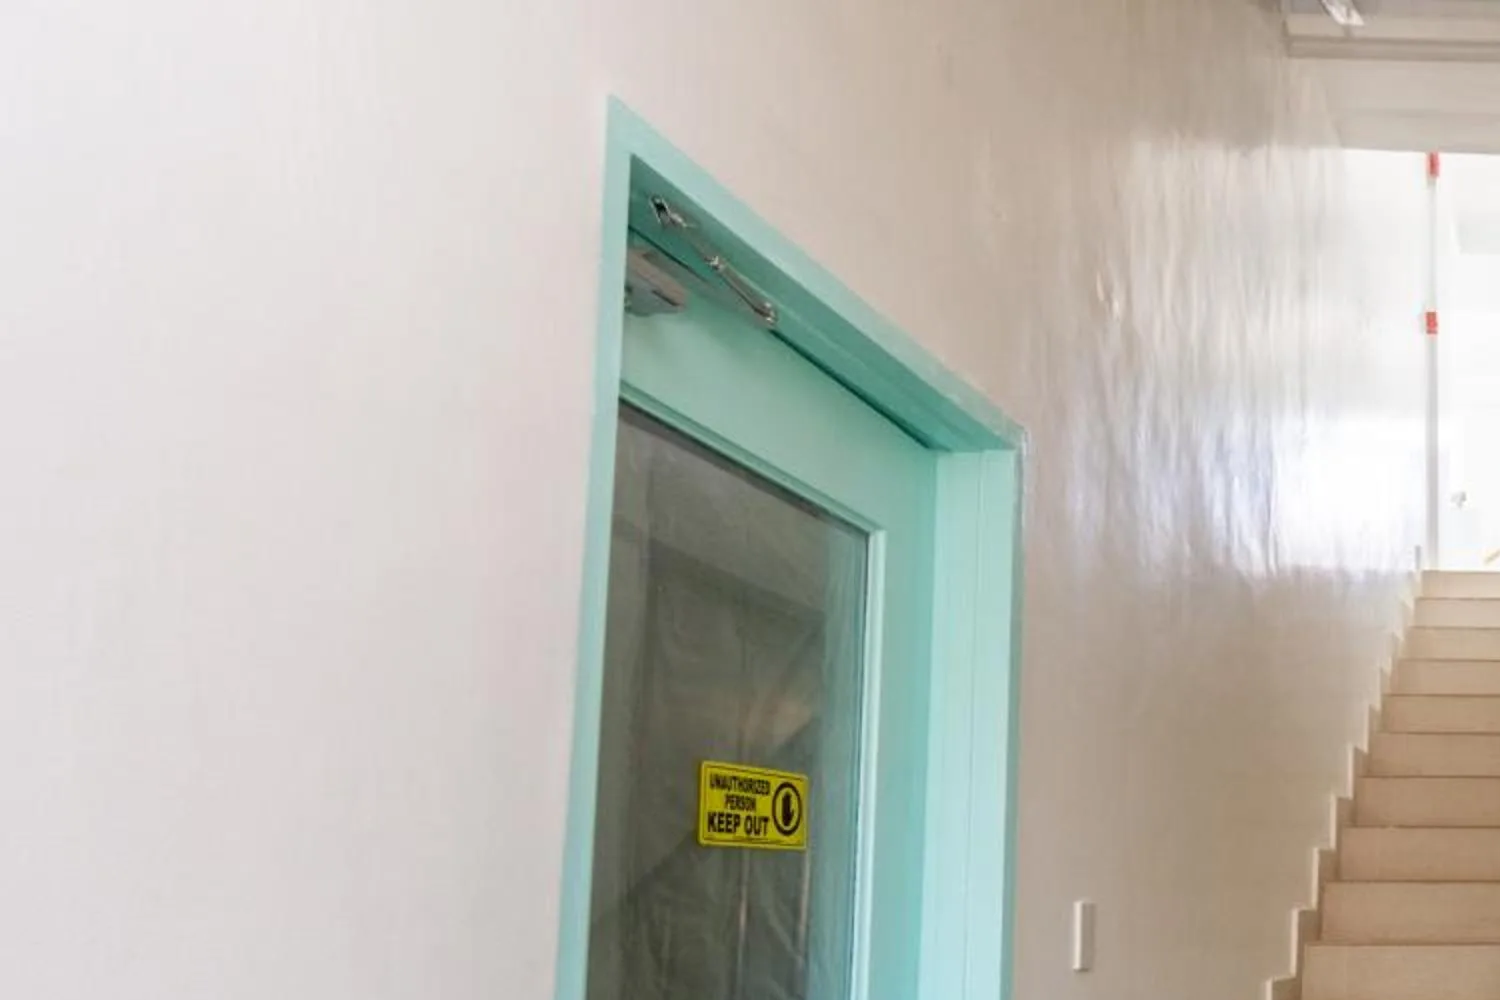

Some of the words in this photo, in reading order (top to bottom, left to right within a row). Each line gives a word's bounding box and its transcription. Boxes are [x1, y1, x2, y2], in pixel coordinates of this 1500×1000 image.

[725, 793, 756, 811] PERSON
[707, 812, 740, 833] KEEP
[744, 815, 769, 836] OUT
